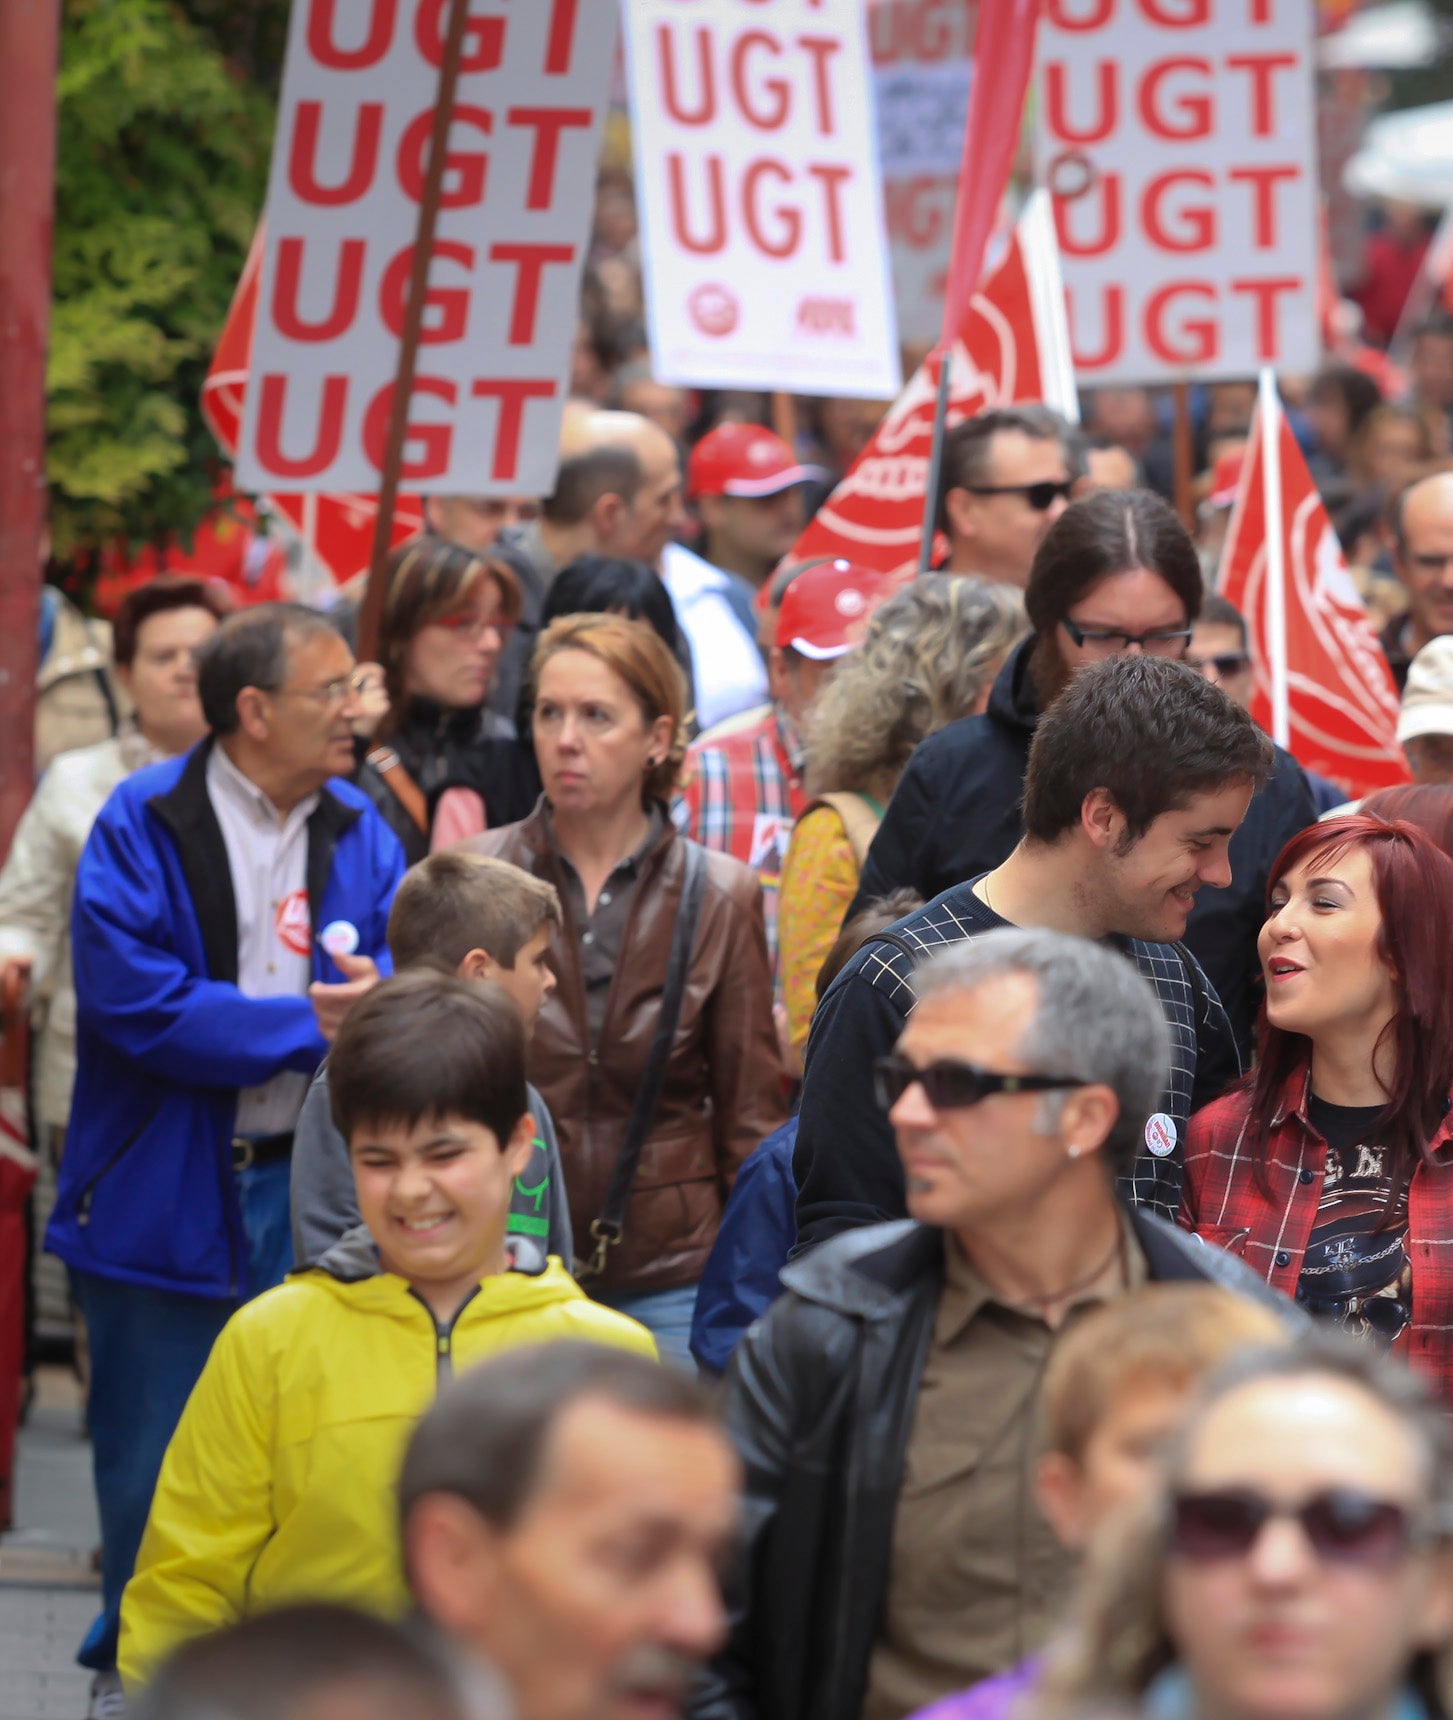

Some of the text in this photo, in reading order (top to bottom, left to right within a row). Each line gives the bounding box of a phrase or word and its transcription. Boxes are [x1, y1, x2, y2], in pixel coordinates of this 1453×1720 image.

[658, 24, 841, 136] UGT
[1045, 54, 1297, 145] UGT
[286, 101, 593, 211] UGT
[668, 152, 852, 264] UGT
[1051, 166, 1301, 259] UGT
[270, 237, 576, 346] UGT
[1064, 279, 1301, 371] UGT
[253, 373, 557, 482] UGT
